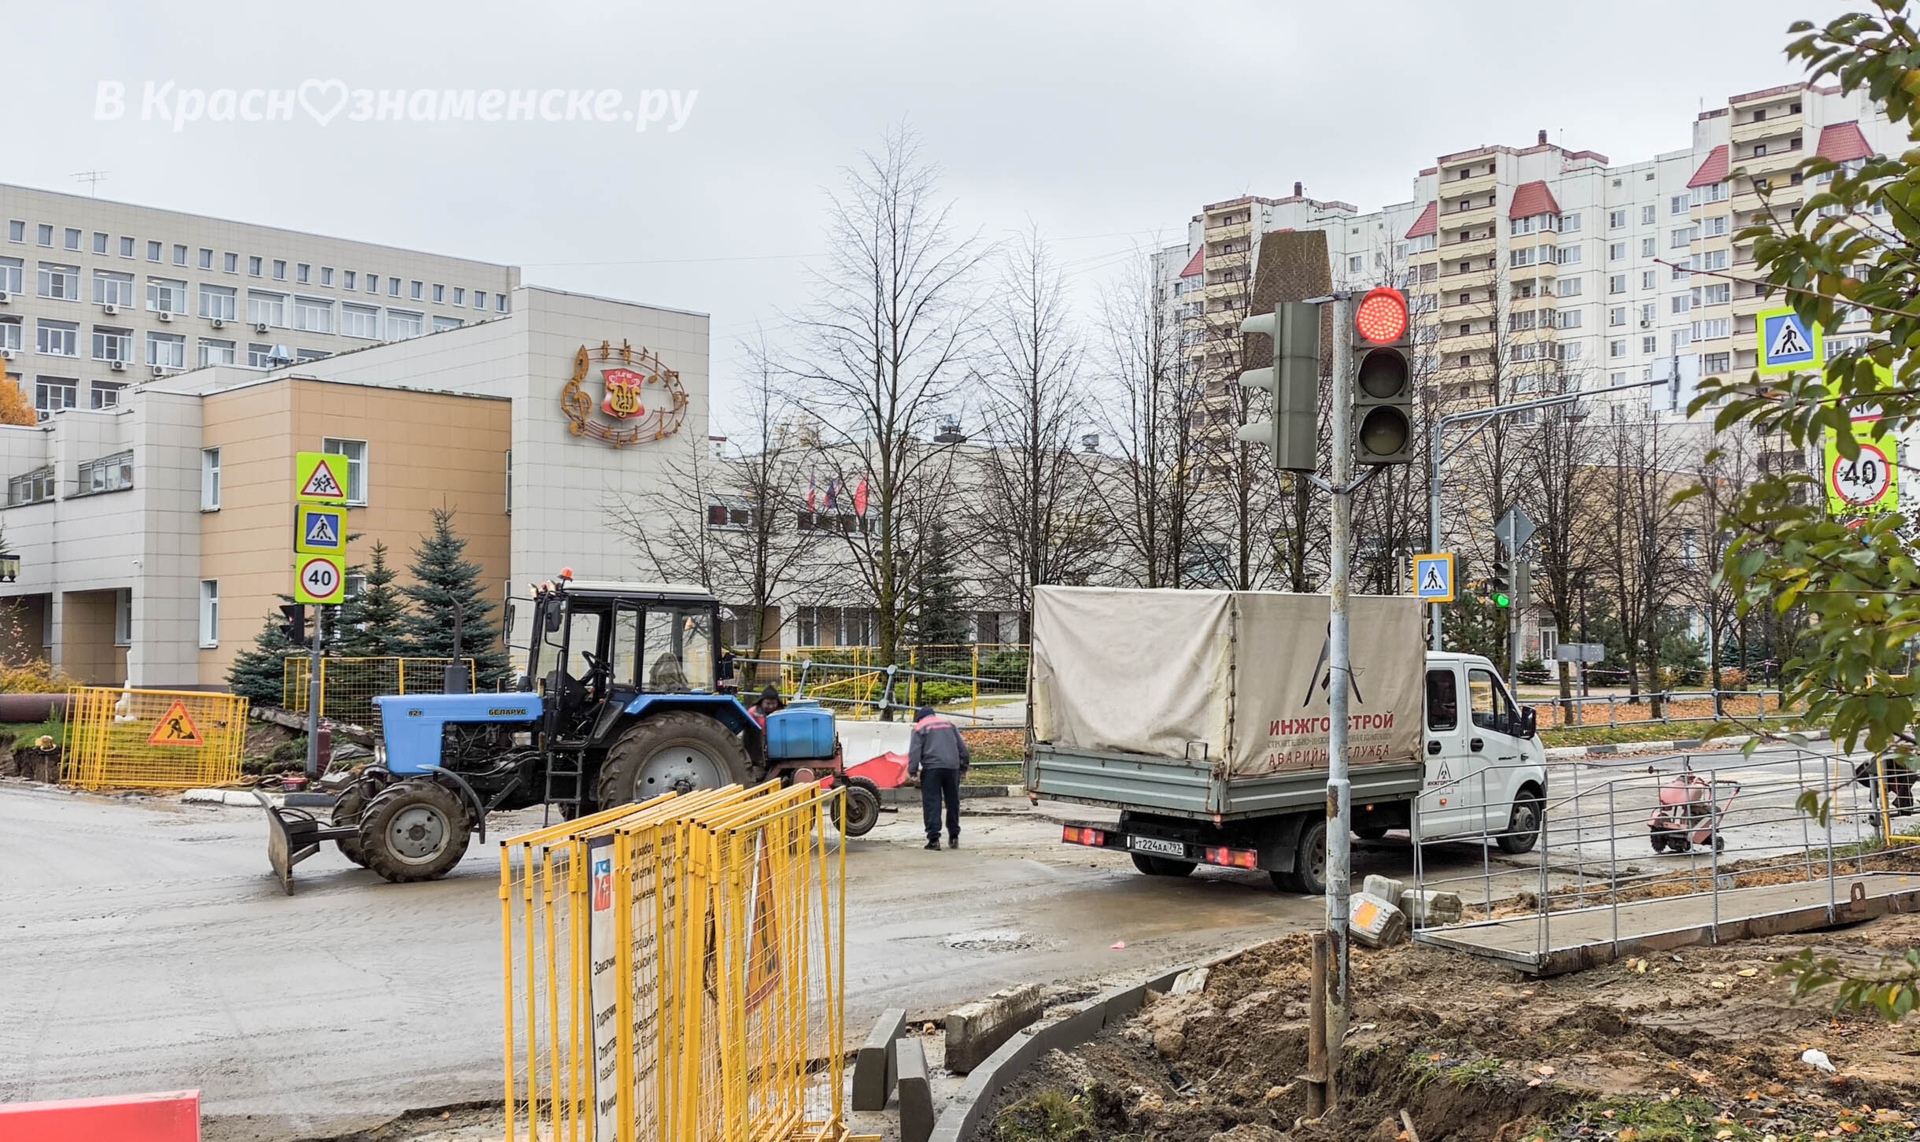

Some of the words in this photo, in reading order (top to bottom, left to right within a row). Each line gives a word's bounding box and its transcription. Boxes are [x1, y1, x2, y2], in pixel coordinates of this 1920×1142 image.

[1843, 460, 1876, 486] 40
[309, 570, 331, 587] 40
[488, 708, 527, 716] БЕЛАРУС
[1269, 711, 1393, 736] ИНЖГОТРОЙ
[1269, 748, 1330, 766] АВАРИЙН
